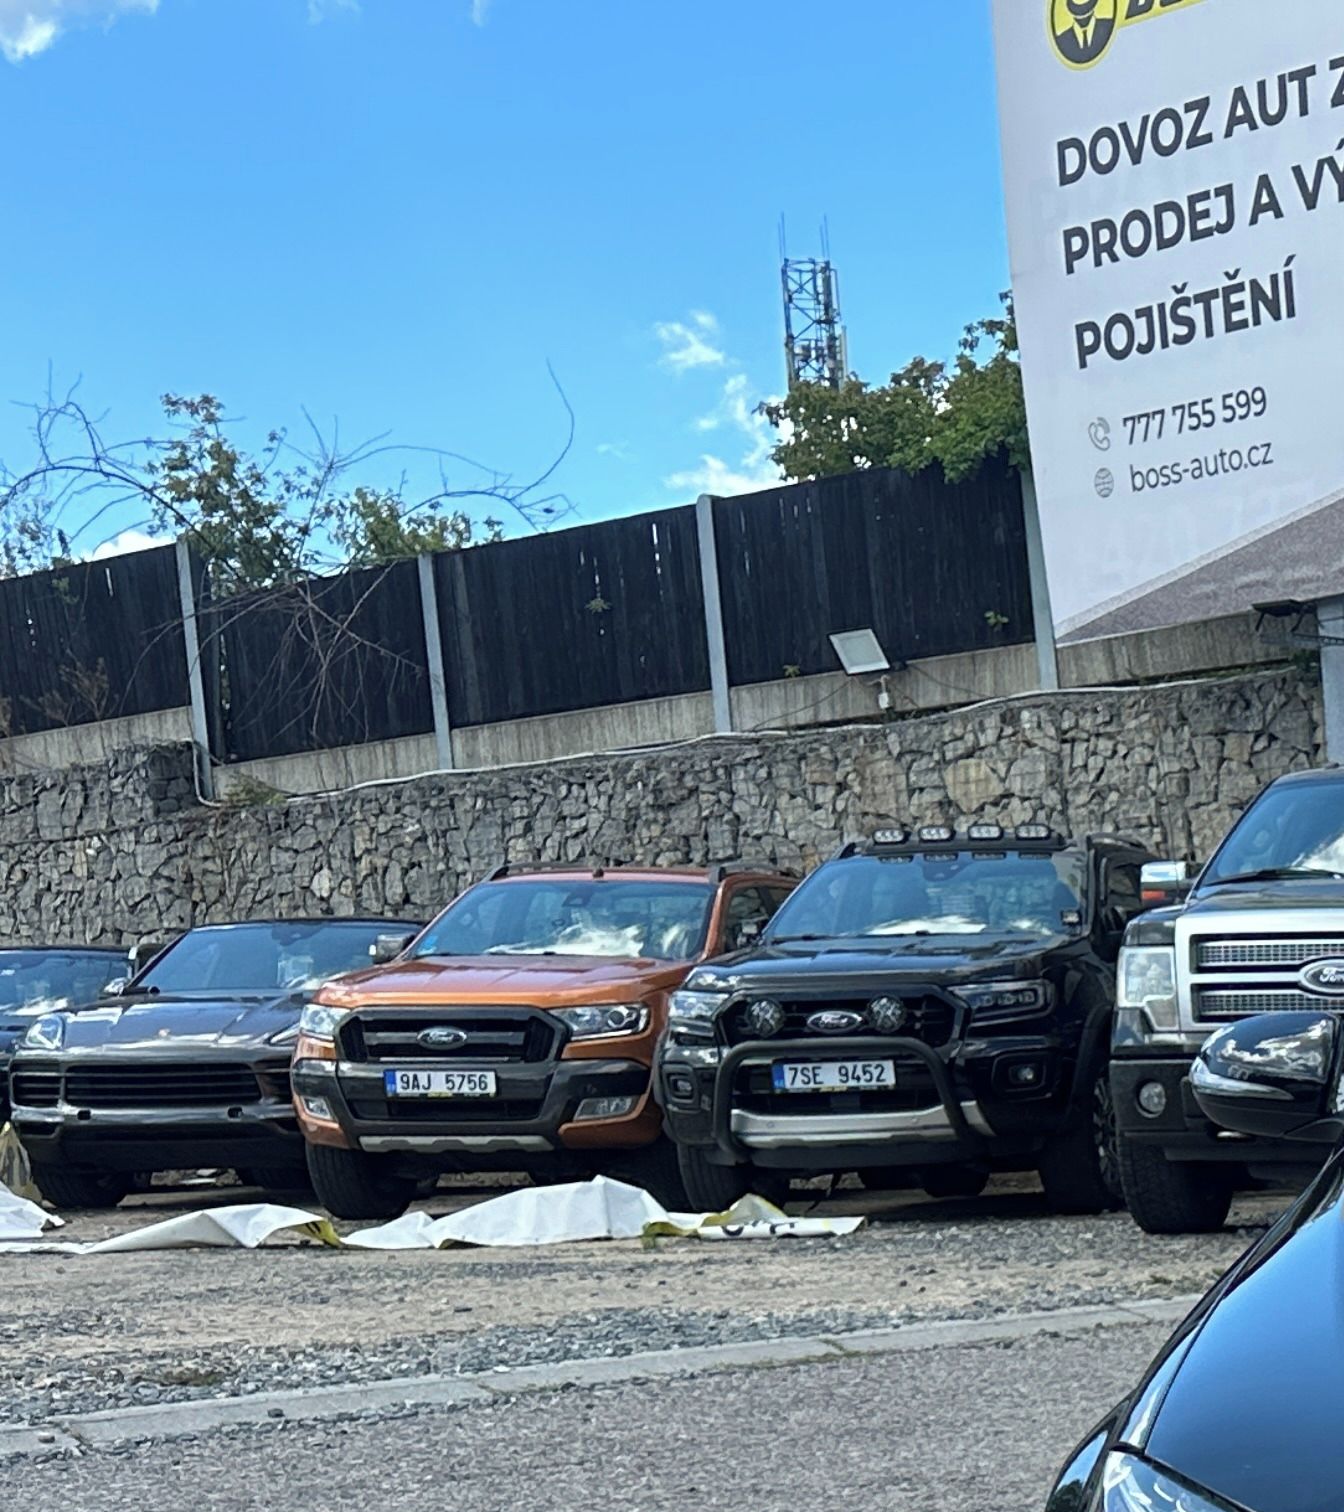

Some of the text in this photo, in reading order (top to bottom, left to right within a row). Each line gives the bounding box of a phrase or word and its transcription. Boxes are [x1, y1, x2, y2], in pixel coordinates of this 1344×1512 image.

[1057, 96, 1213, 187] DOVOZ
[1224, 64, 1317, 139] AUT
[1063, 183, 1235, 275] PRODEJ
[1248, 174, 1284, 226] A
[1074, 254, 1297, 369] POJIŠTĚNÍ
[1122, 386, 1267, 446] 777 755 599
[1129, 442, 1274, 493] boss-auto.cz
[400, 1073, 489, 1092] 9AJ 5756
[788, 1063, 886, 1086] 7SE 9452
